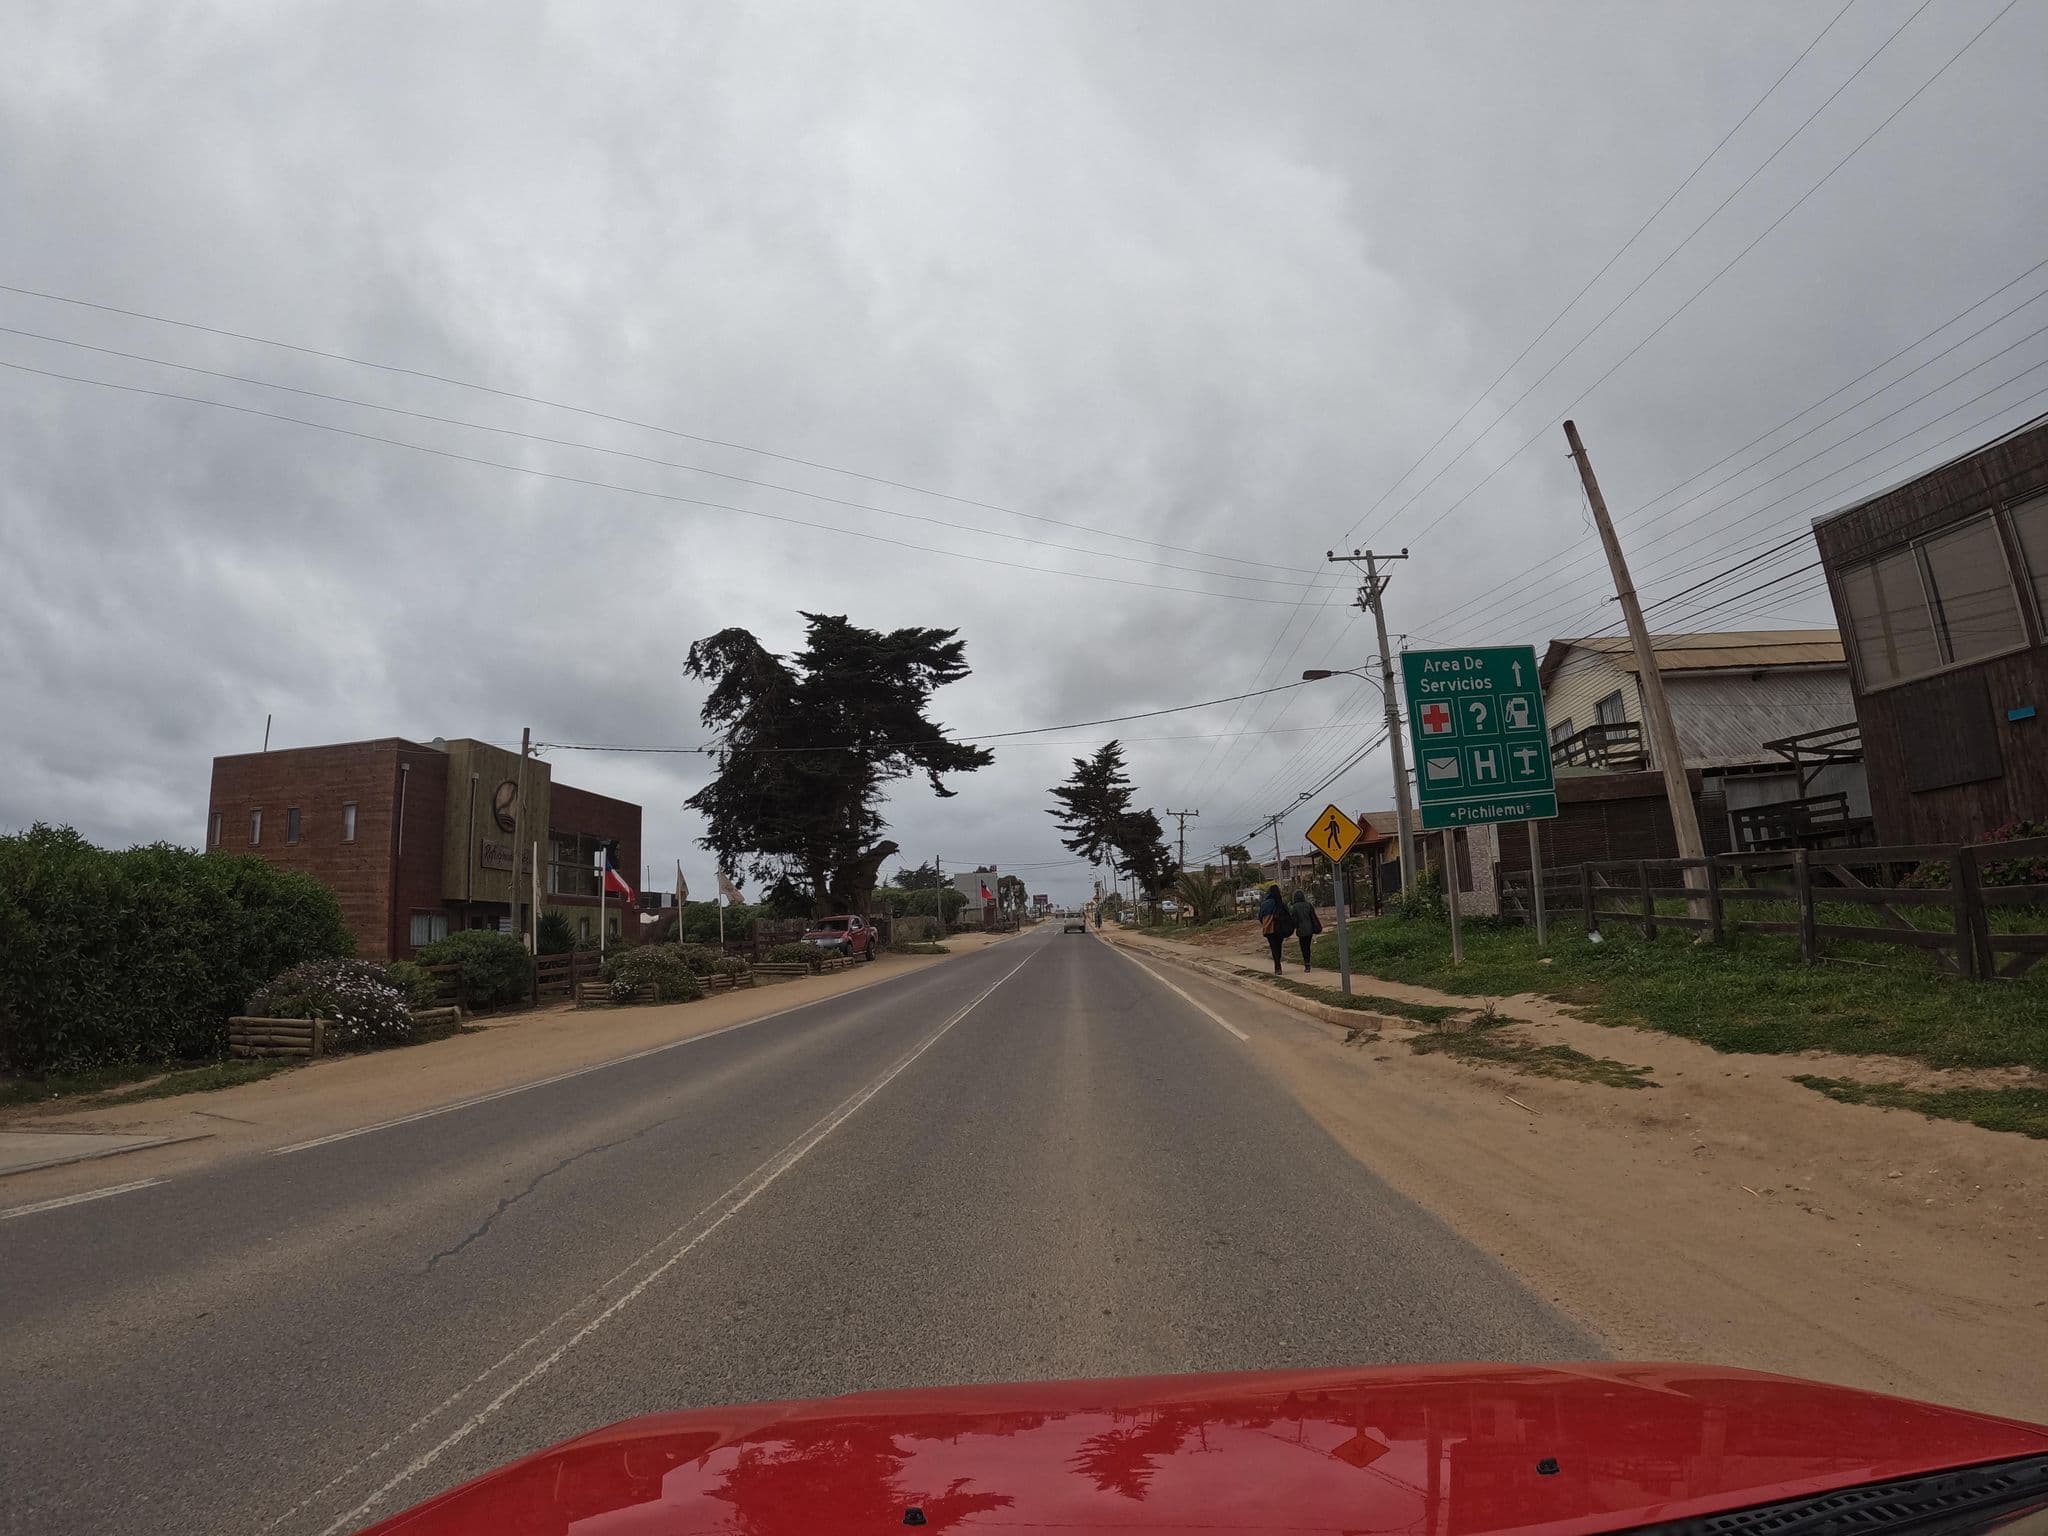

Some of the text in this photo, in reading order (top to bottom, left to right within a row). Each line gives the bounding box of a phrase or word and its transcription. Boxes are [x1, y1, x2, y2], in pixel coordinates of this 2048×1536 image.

[1424, 656, 1484, 673] Area De
[1420, 677, 1493, 693] Servicios
[1473, 749, 1498, 780] H
[1457, 805, 1525, 820] Pichilemu
